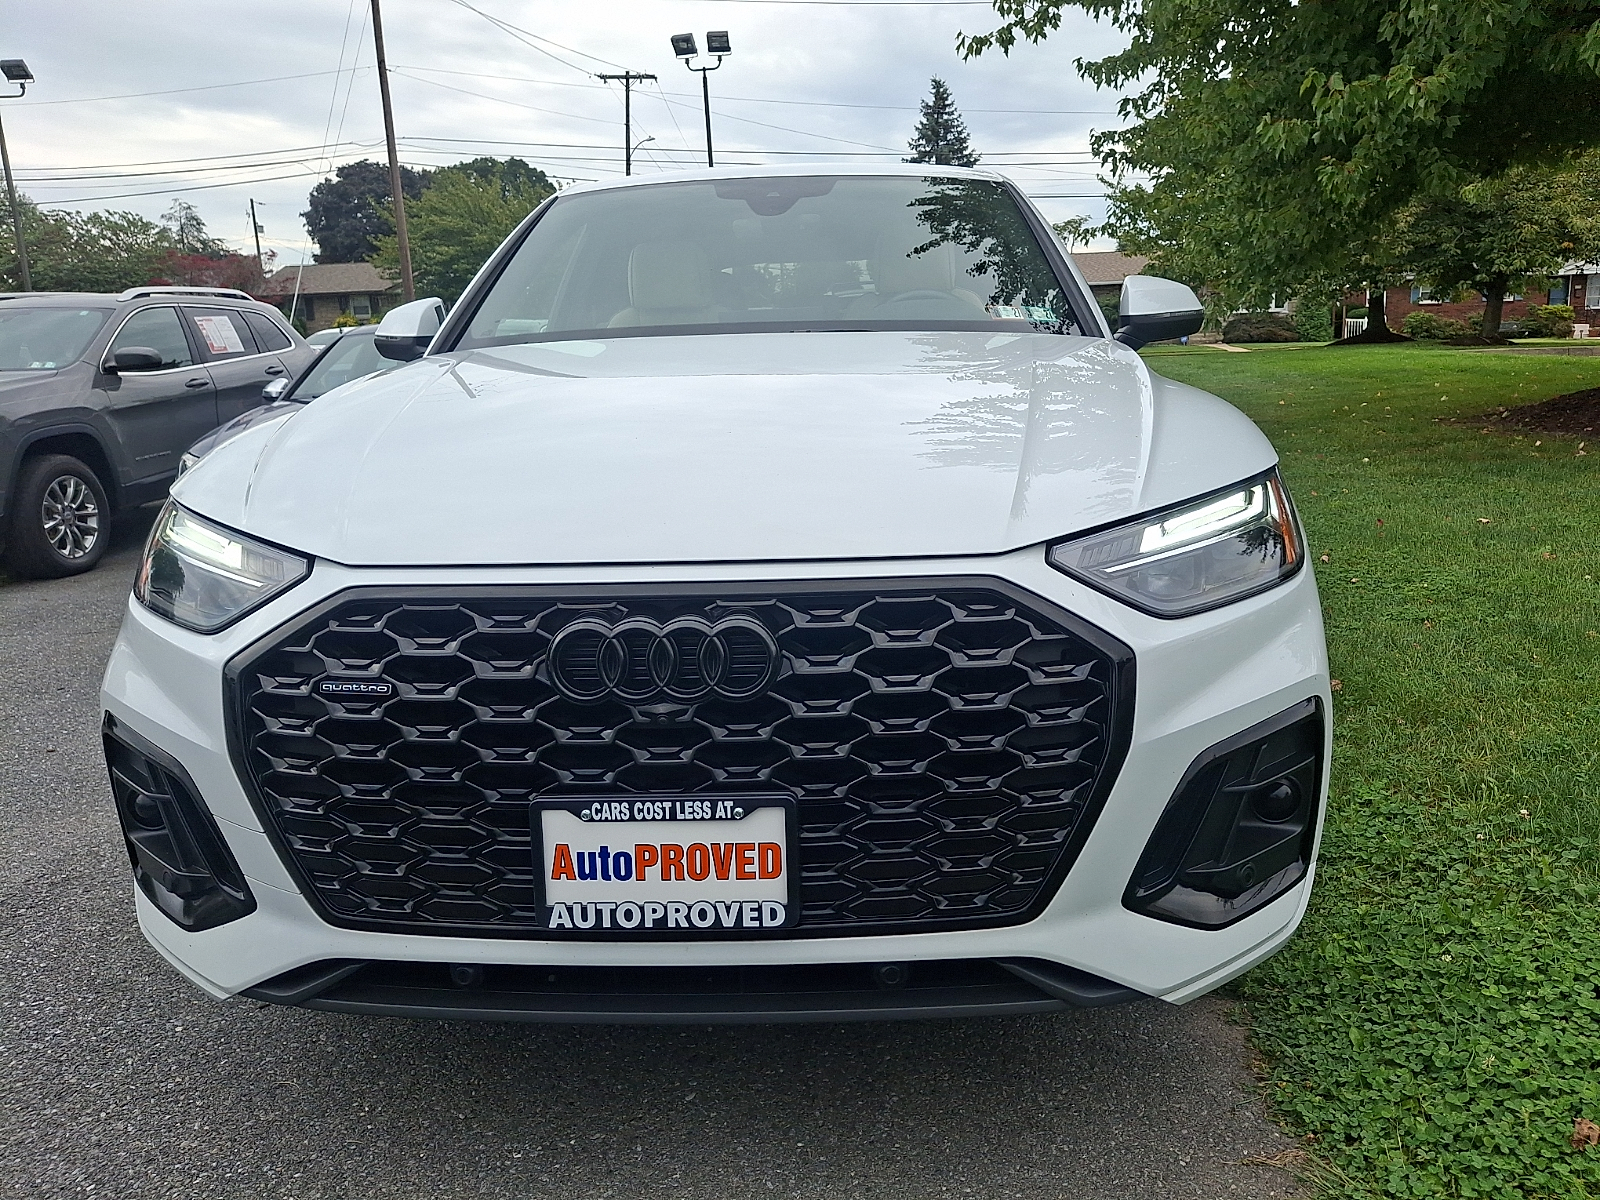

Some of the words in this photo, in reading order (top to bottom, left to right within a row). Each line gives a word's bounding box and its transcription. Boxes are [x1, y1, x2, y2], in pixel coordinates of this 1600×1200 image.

[322, 683, 388, 692] quattro
[591, 802, 630, 821] CARS
[634, 801, 672, 820] COST
[676, 801, 712, 820] LESS
[715, 801, 734, 819] AT
[551, 842, 783, 882] AutoPROVED
[549, 901, 786, 929] AUTOPROVED
